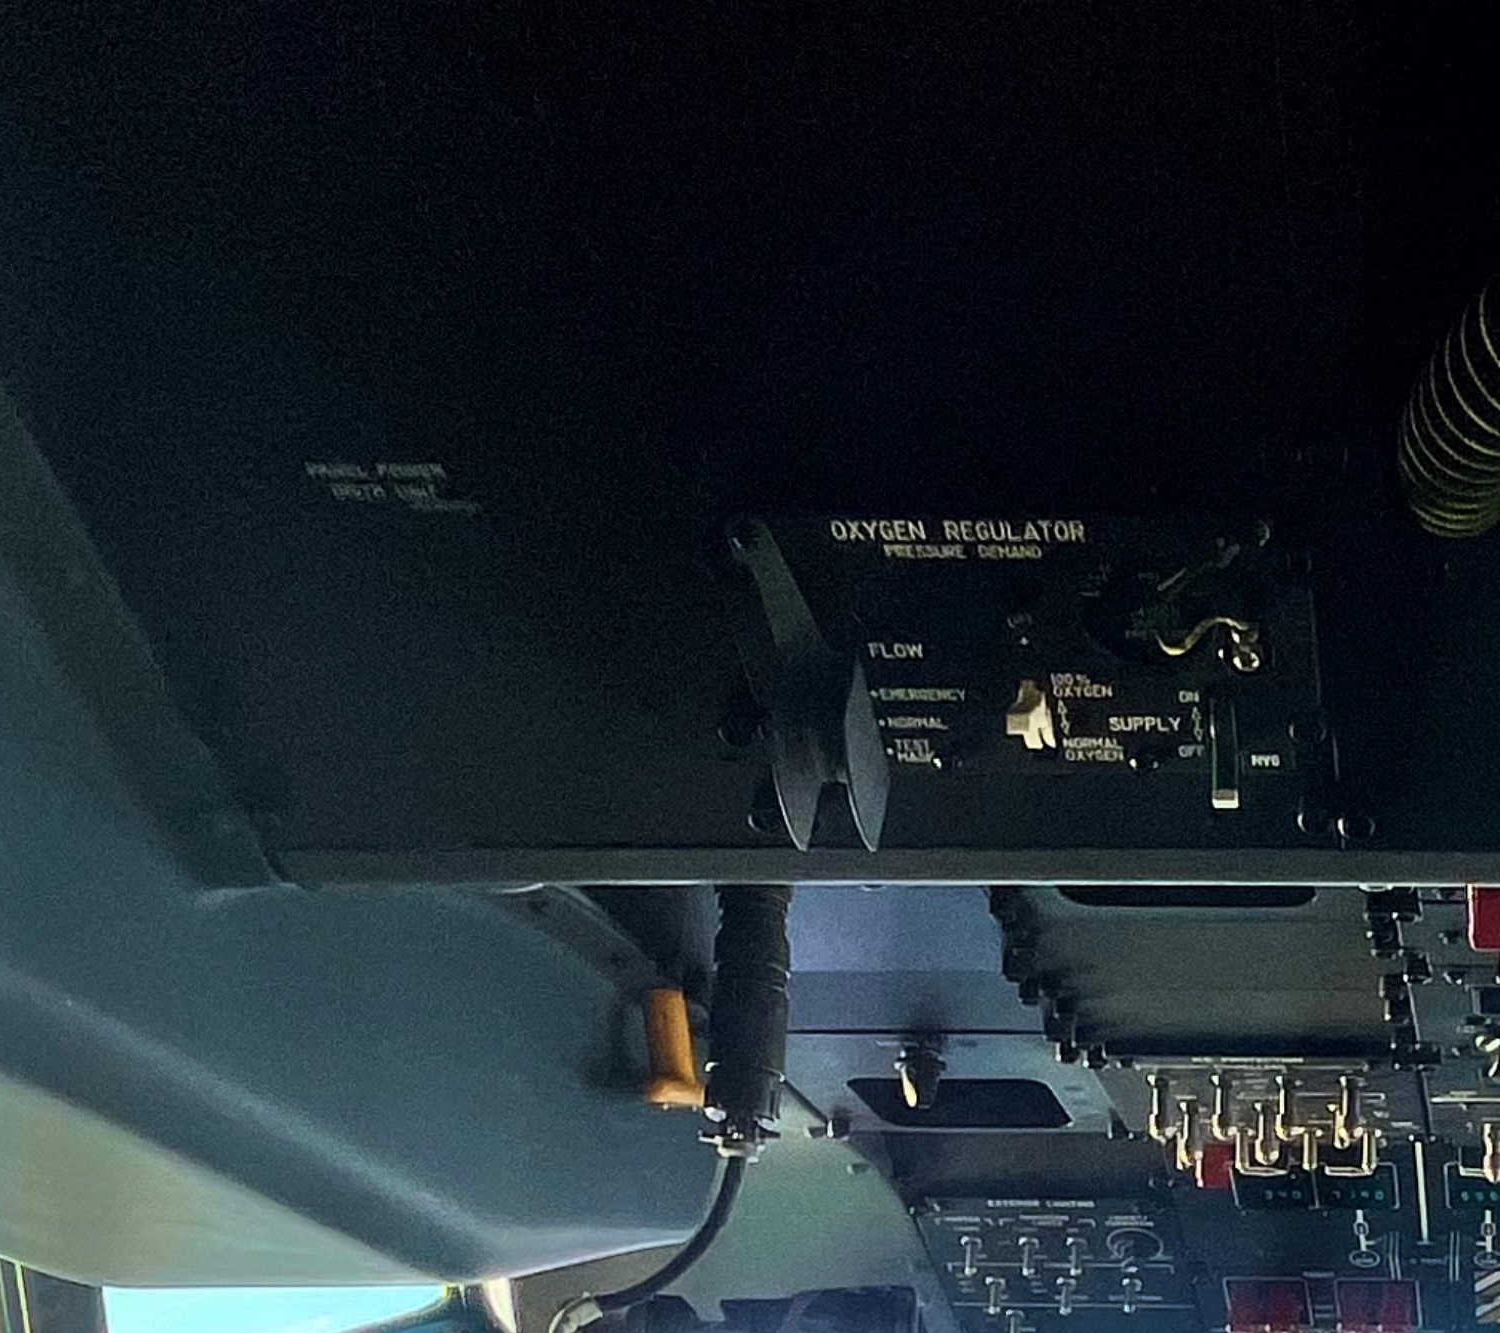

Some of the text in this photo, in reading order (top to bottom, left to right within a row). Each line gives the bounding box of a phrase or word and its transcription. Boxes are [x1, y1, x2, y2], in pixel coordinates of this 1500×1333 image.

[830, 519, 1087, 543] OXYGEN REGULATOR
[883, 544, 1043, 560] PRESSURE DEMAND
[867, 642, 924, 658] FLOW
[878, 687, 966, 702] EMERGENCY
[1053, 685, 1114, 699] OXYGEN
[1178, 689, 1200, 703] ON
[886, 715, 949, 730] NORMAL
[1108, 716, 1182, 732] SUPPLY
[1063, 737, 1125, 751] NORMAL
[1065, 749, 1125, 763] OXYGEN
